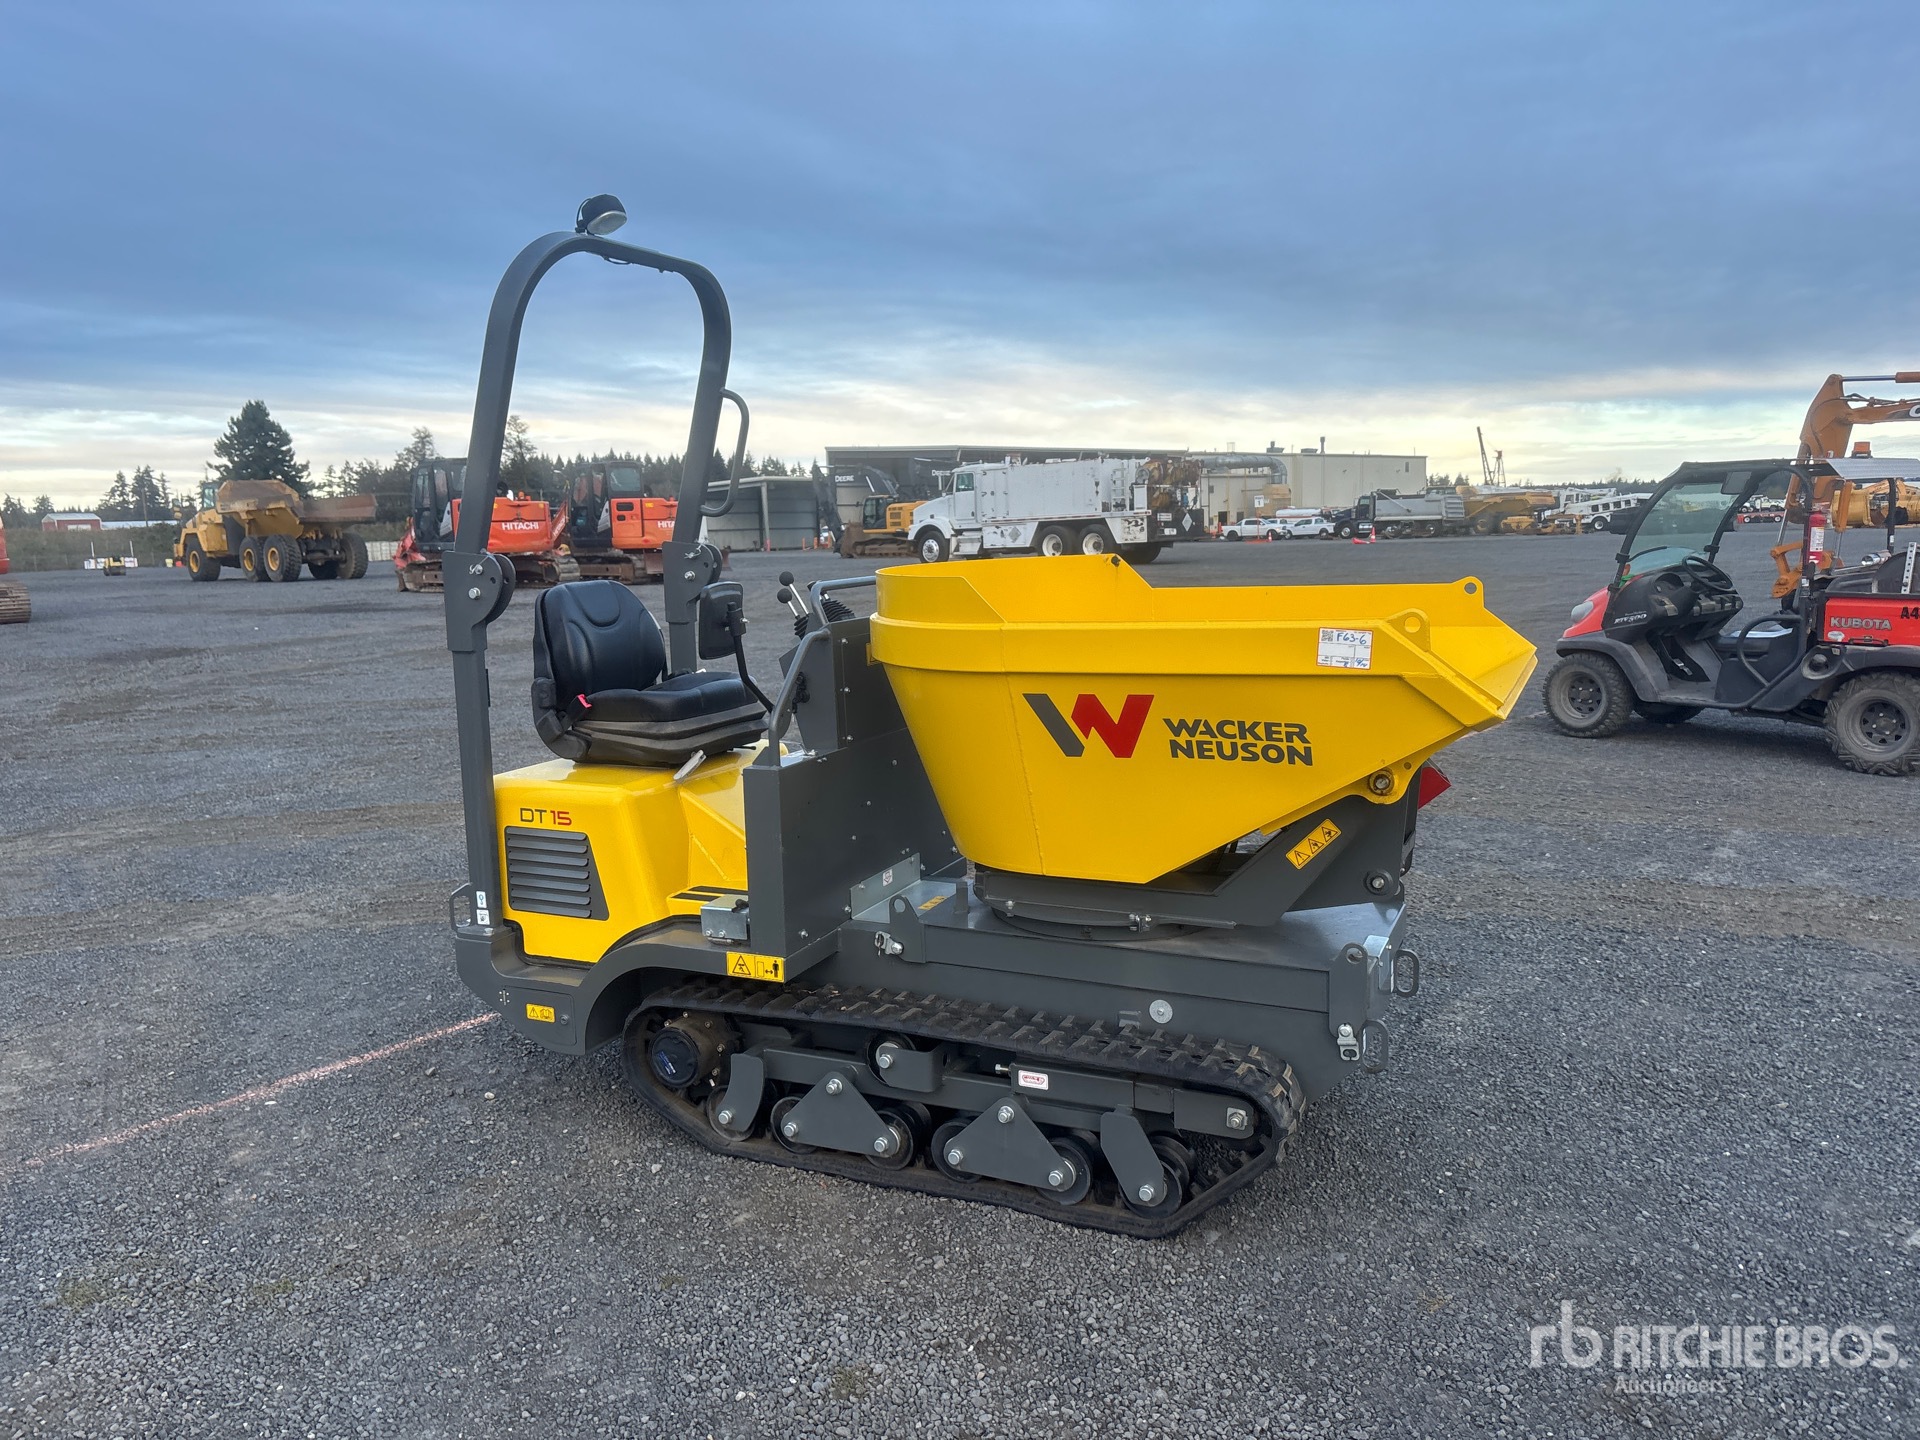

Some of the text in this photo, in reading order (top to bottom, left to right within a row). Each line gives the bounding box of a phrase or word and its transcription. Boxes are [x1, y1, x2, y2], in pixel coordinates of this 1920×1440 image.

[502, 521, 539, 531] HITACHI
[657, 520, 675, 529] HITA
[1830, 616, 1893, 631] KUBOTA
[1336, 632, 1367, 645] F63-6
[1162, 718, 1312, 744] WACKER
[1169, 739, 1314, 767] NEUSON
